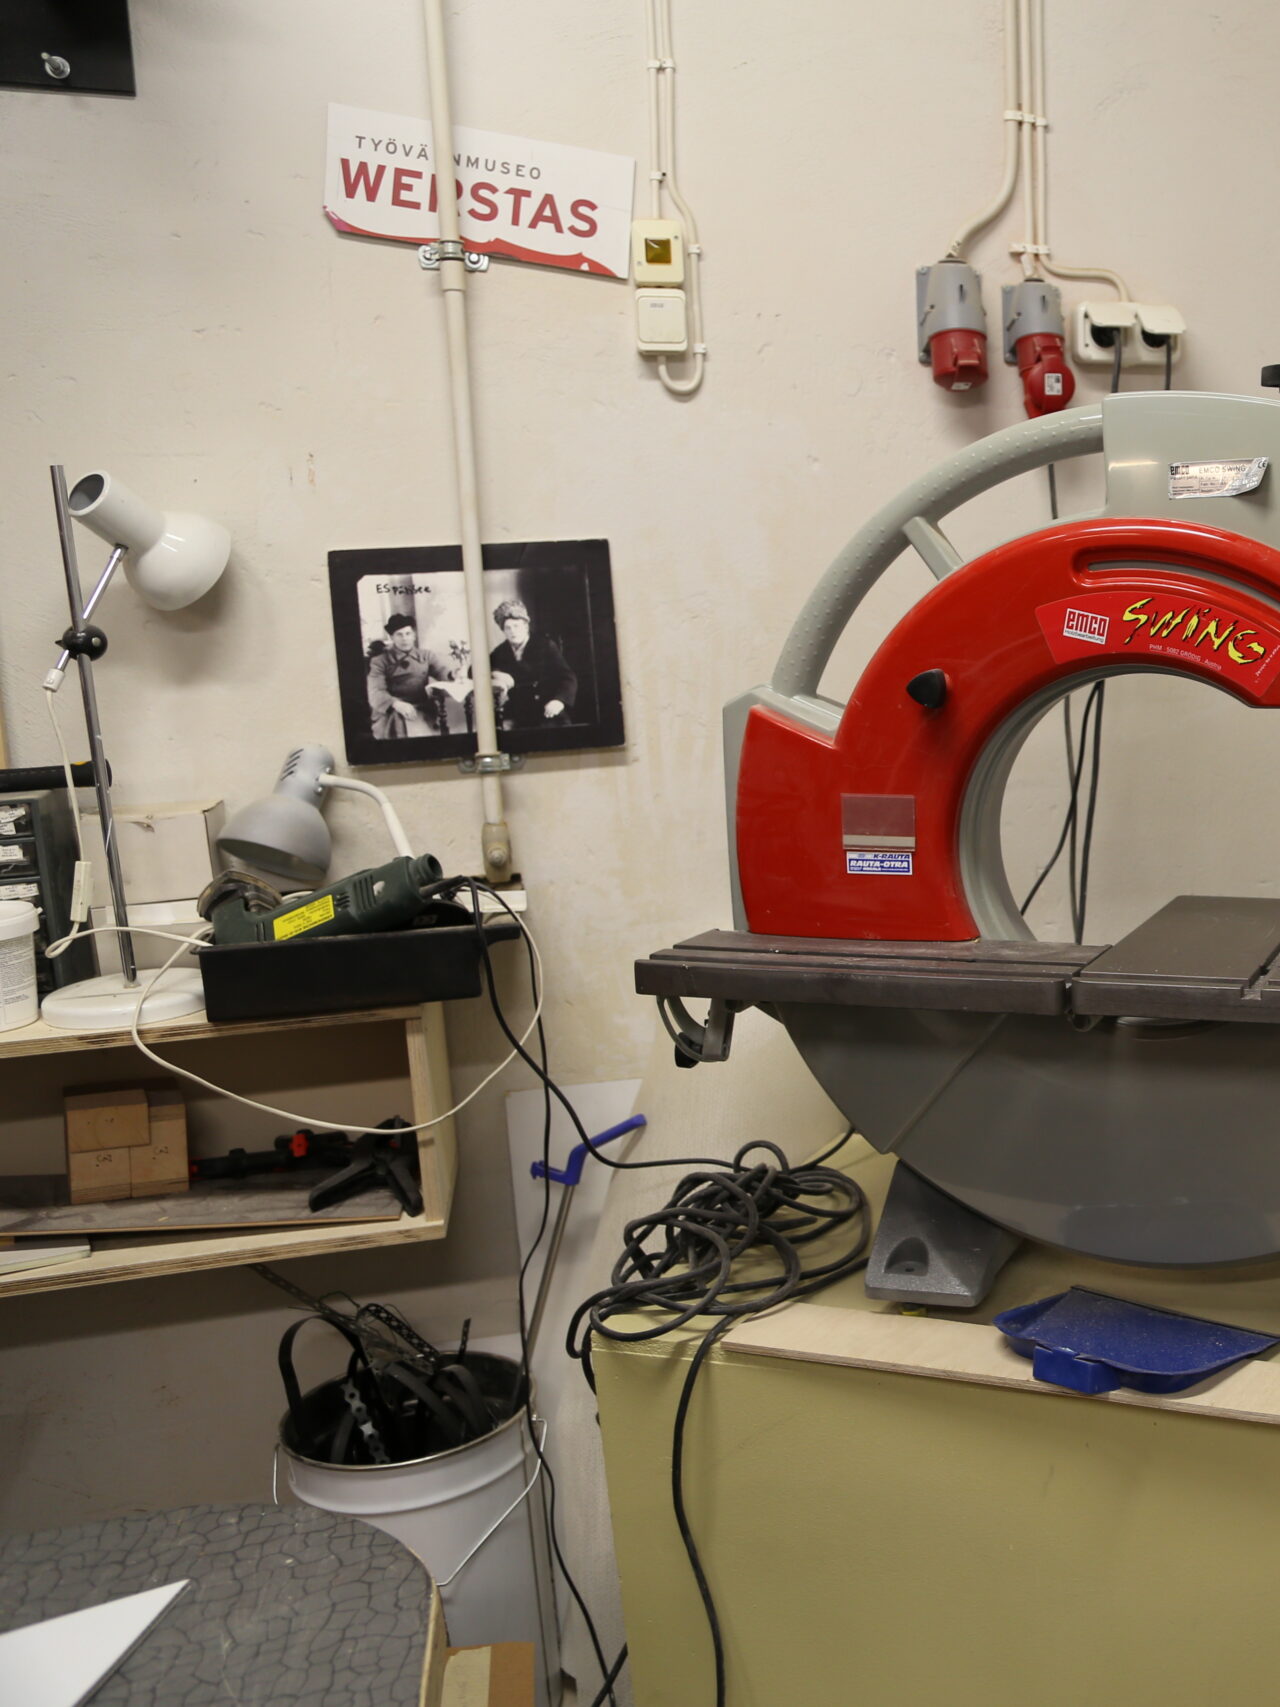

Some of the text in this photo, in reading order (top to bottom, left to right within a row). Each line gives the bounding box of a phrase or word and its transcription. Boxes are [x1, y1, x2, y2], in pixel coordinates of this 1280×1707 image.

[354, 135, 541, 180] TYÖVÄNMUSEO
[1222, 465, 1246, 473] SWING
[850, 860, 908, 868] RAUTA-OTRA
